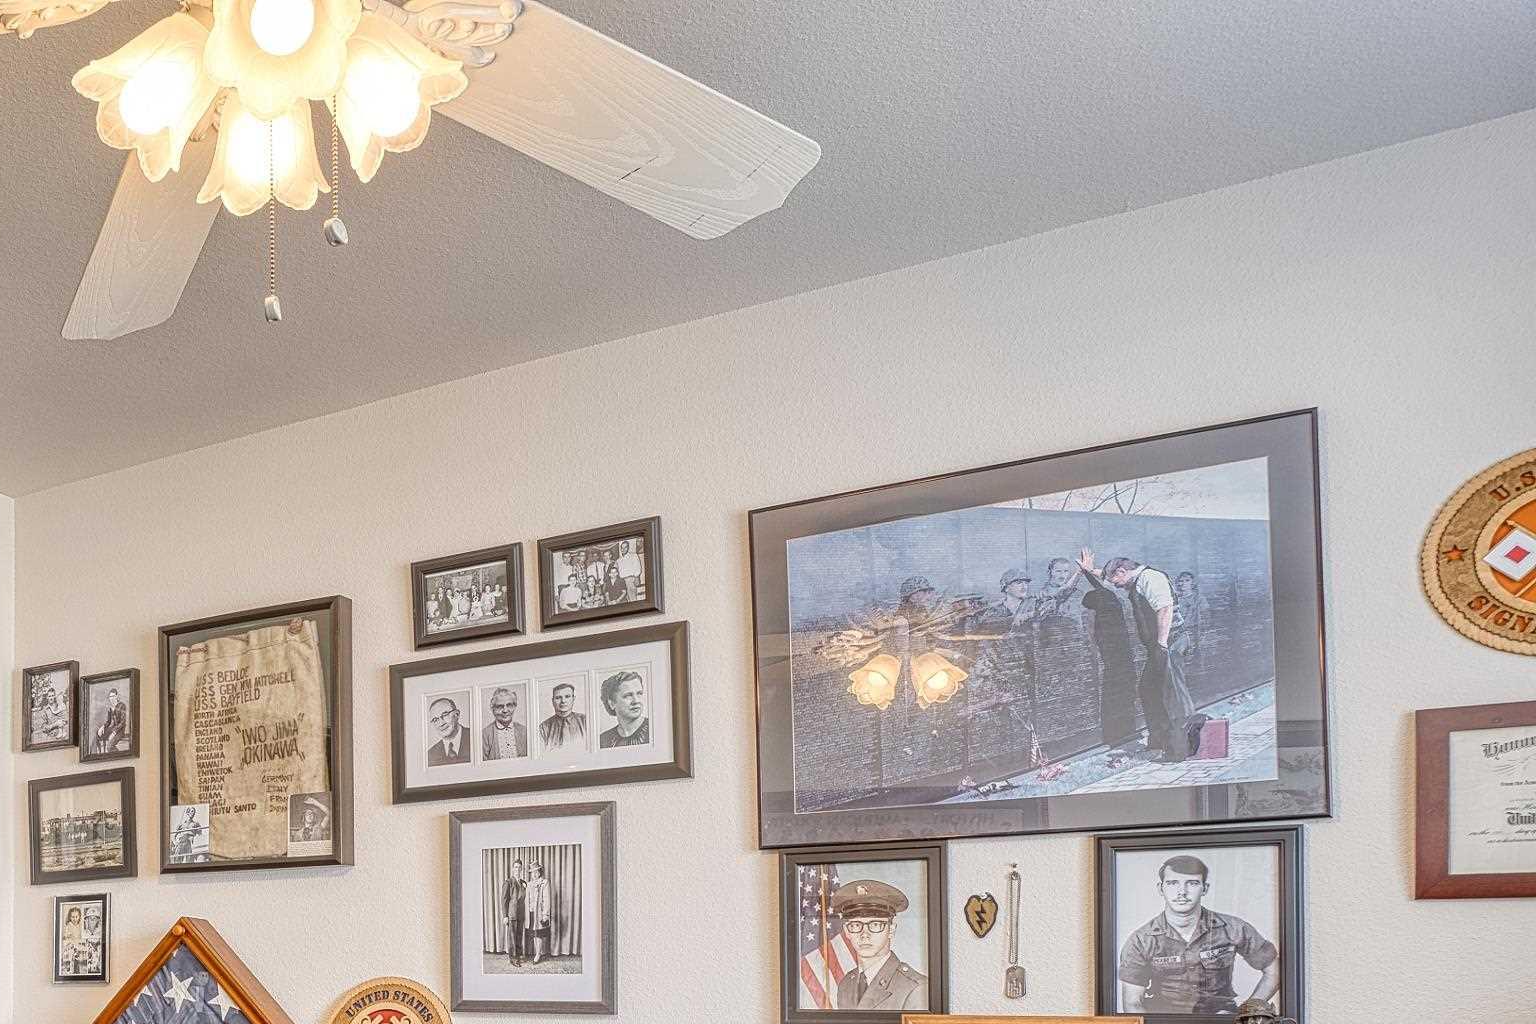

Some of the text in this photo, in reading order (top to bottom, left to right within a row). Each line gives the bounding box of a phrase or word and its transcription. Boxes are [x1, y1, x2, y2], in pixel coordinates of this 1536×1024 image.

[195, 686, 215, 700] USS
[195, 688, 260, 711] USS BAYFIELD
[346, 990, 433, 1022] UNITED STATES
